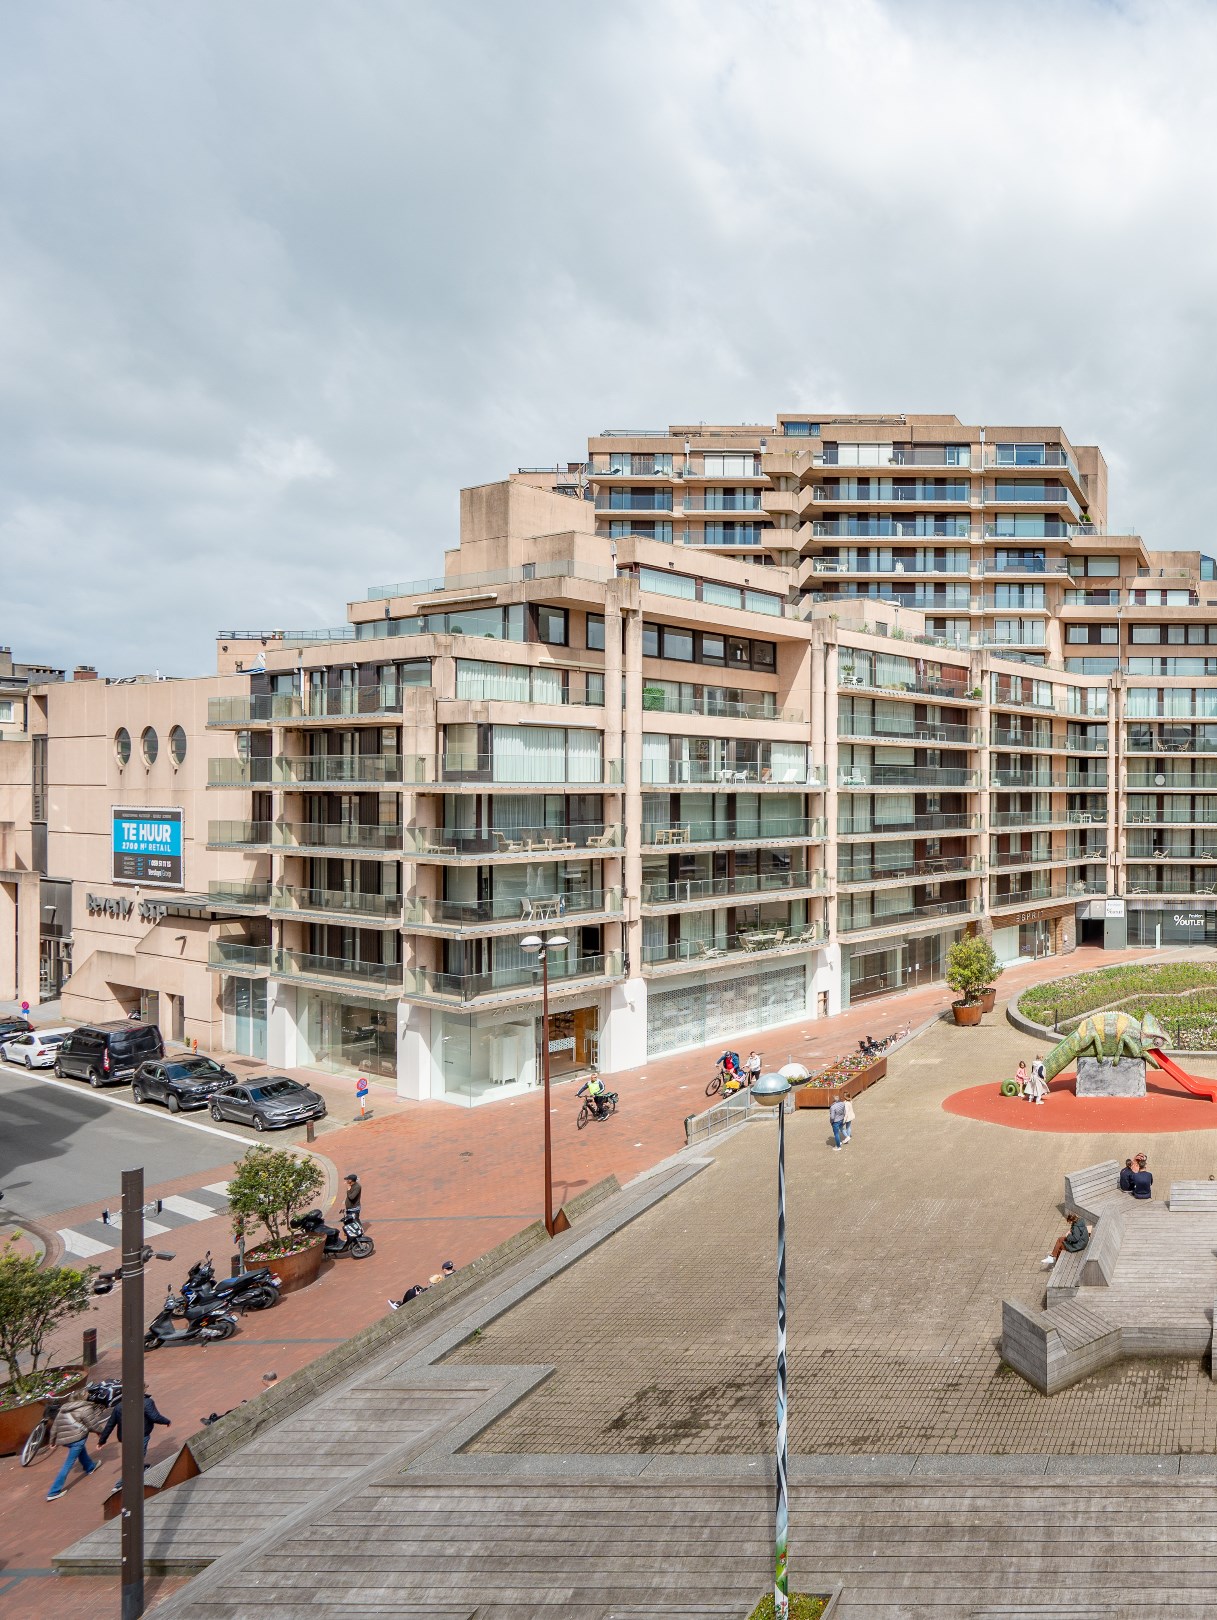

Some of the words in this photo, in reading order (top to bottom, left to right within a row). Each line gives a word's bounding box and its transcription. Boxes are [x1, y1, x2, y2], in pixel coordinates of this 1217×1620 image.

[122, 823, 137, 840] TE
[139, 824, 171, 842] HUUR
[122, 842, 138, 850] 2700
[148, 844, 172, 852] RETAIL
[1016, 911, 1044, 922] ESPRIT
[492, 1002, 537, 1017] ZARA
